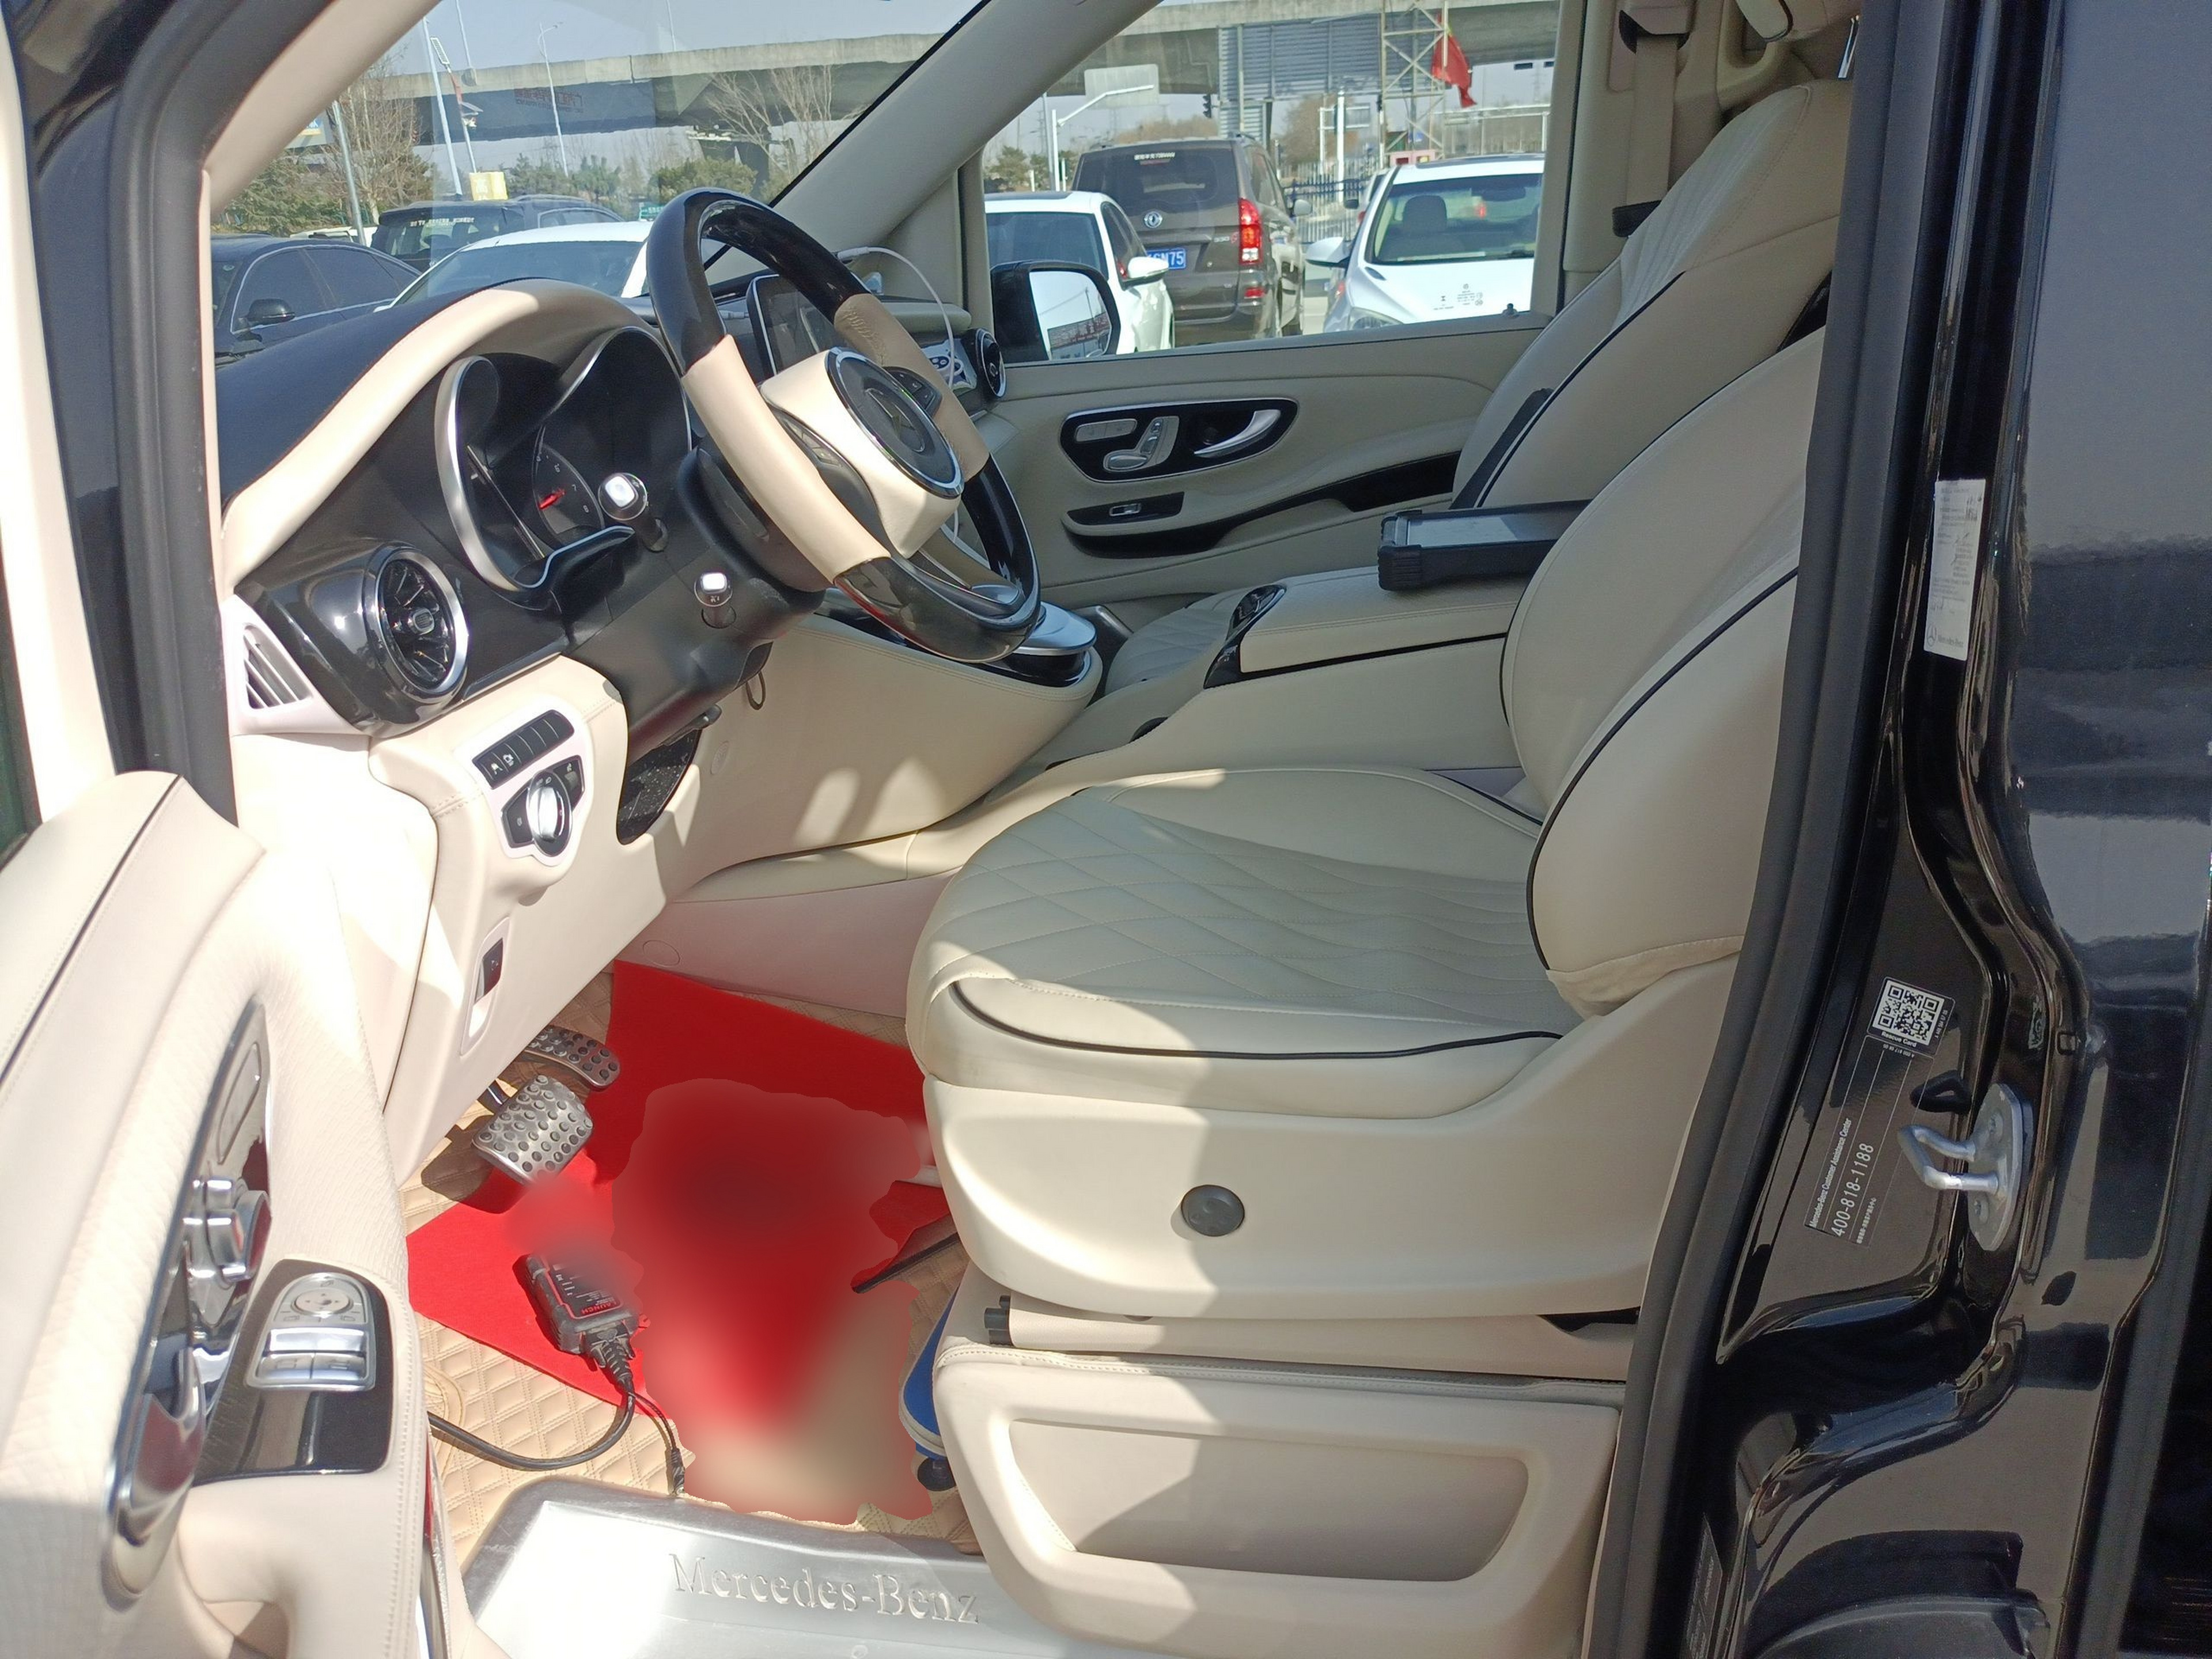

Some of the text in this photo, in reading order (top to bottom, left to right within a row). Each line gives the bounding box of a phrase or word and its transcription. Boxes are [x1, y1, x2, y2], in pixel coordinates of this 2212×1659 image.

[1881, 1031, 1917, 1047] Rescue Card
[1809, 1118, 1851, 1228] Mercedes-Benz Customer Assistance Center
[1831, 1143, 1874, 1236] 400-818-1188
[669, 1554, 979, 1624] Mercedes-Benz
